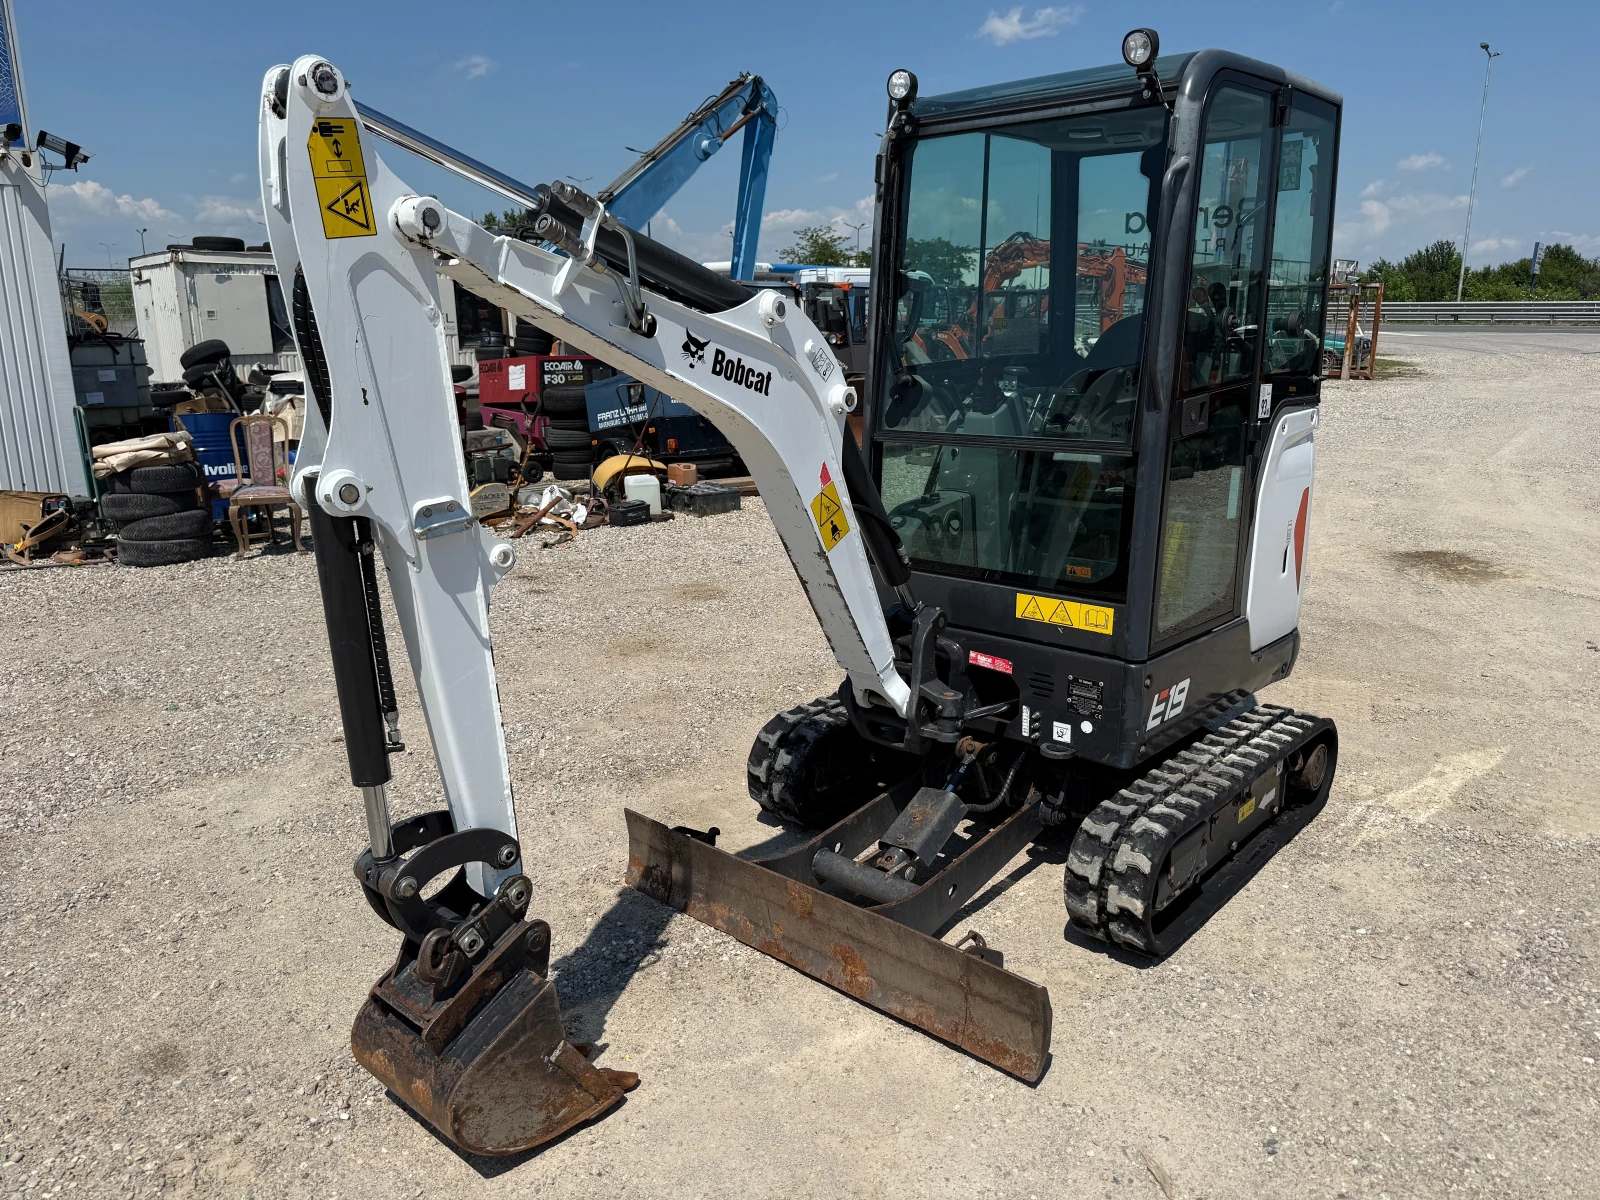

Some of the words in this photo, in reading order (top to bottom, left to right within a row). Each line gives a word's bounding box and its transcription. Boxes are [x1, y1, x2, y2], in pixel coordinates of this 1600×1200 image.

[544, 361, 574, 372] ECOAIR
[711, 347, 772, 397] Bobcat
[544, 374, 566, 385] F30
[597, 409, 619, 421] FRANZ
[478, 492, 505, 500] WACKER
[1146, 677, 1191, 732] E19
